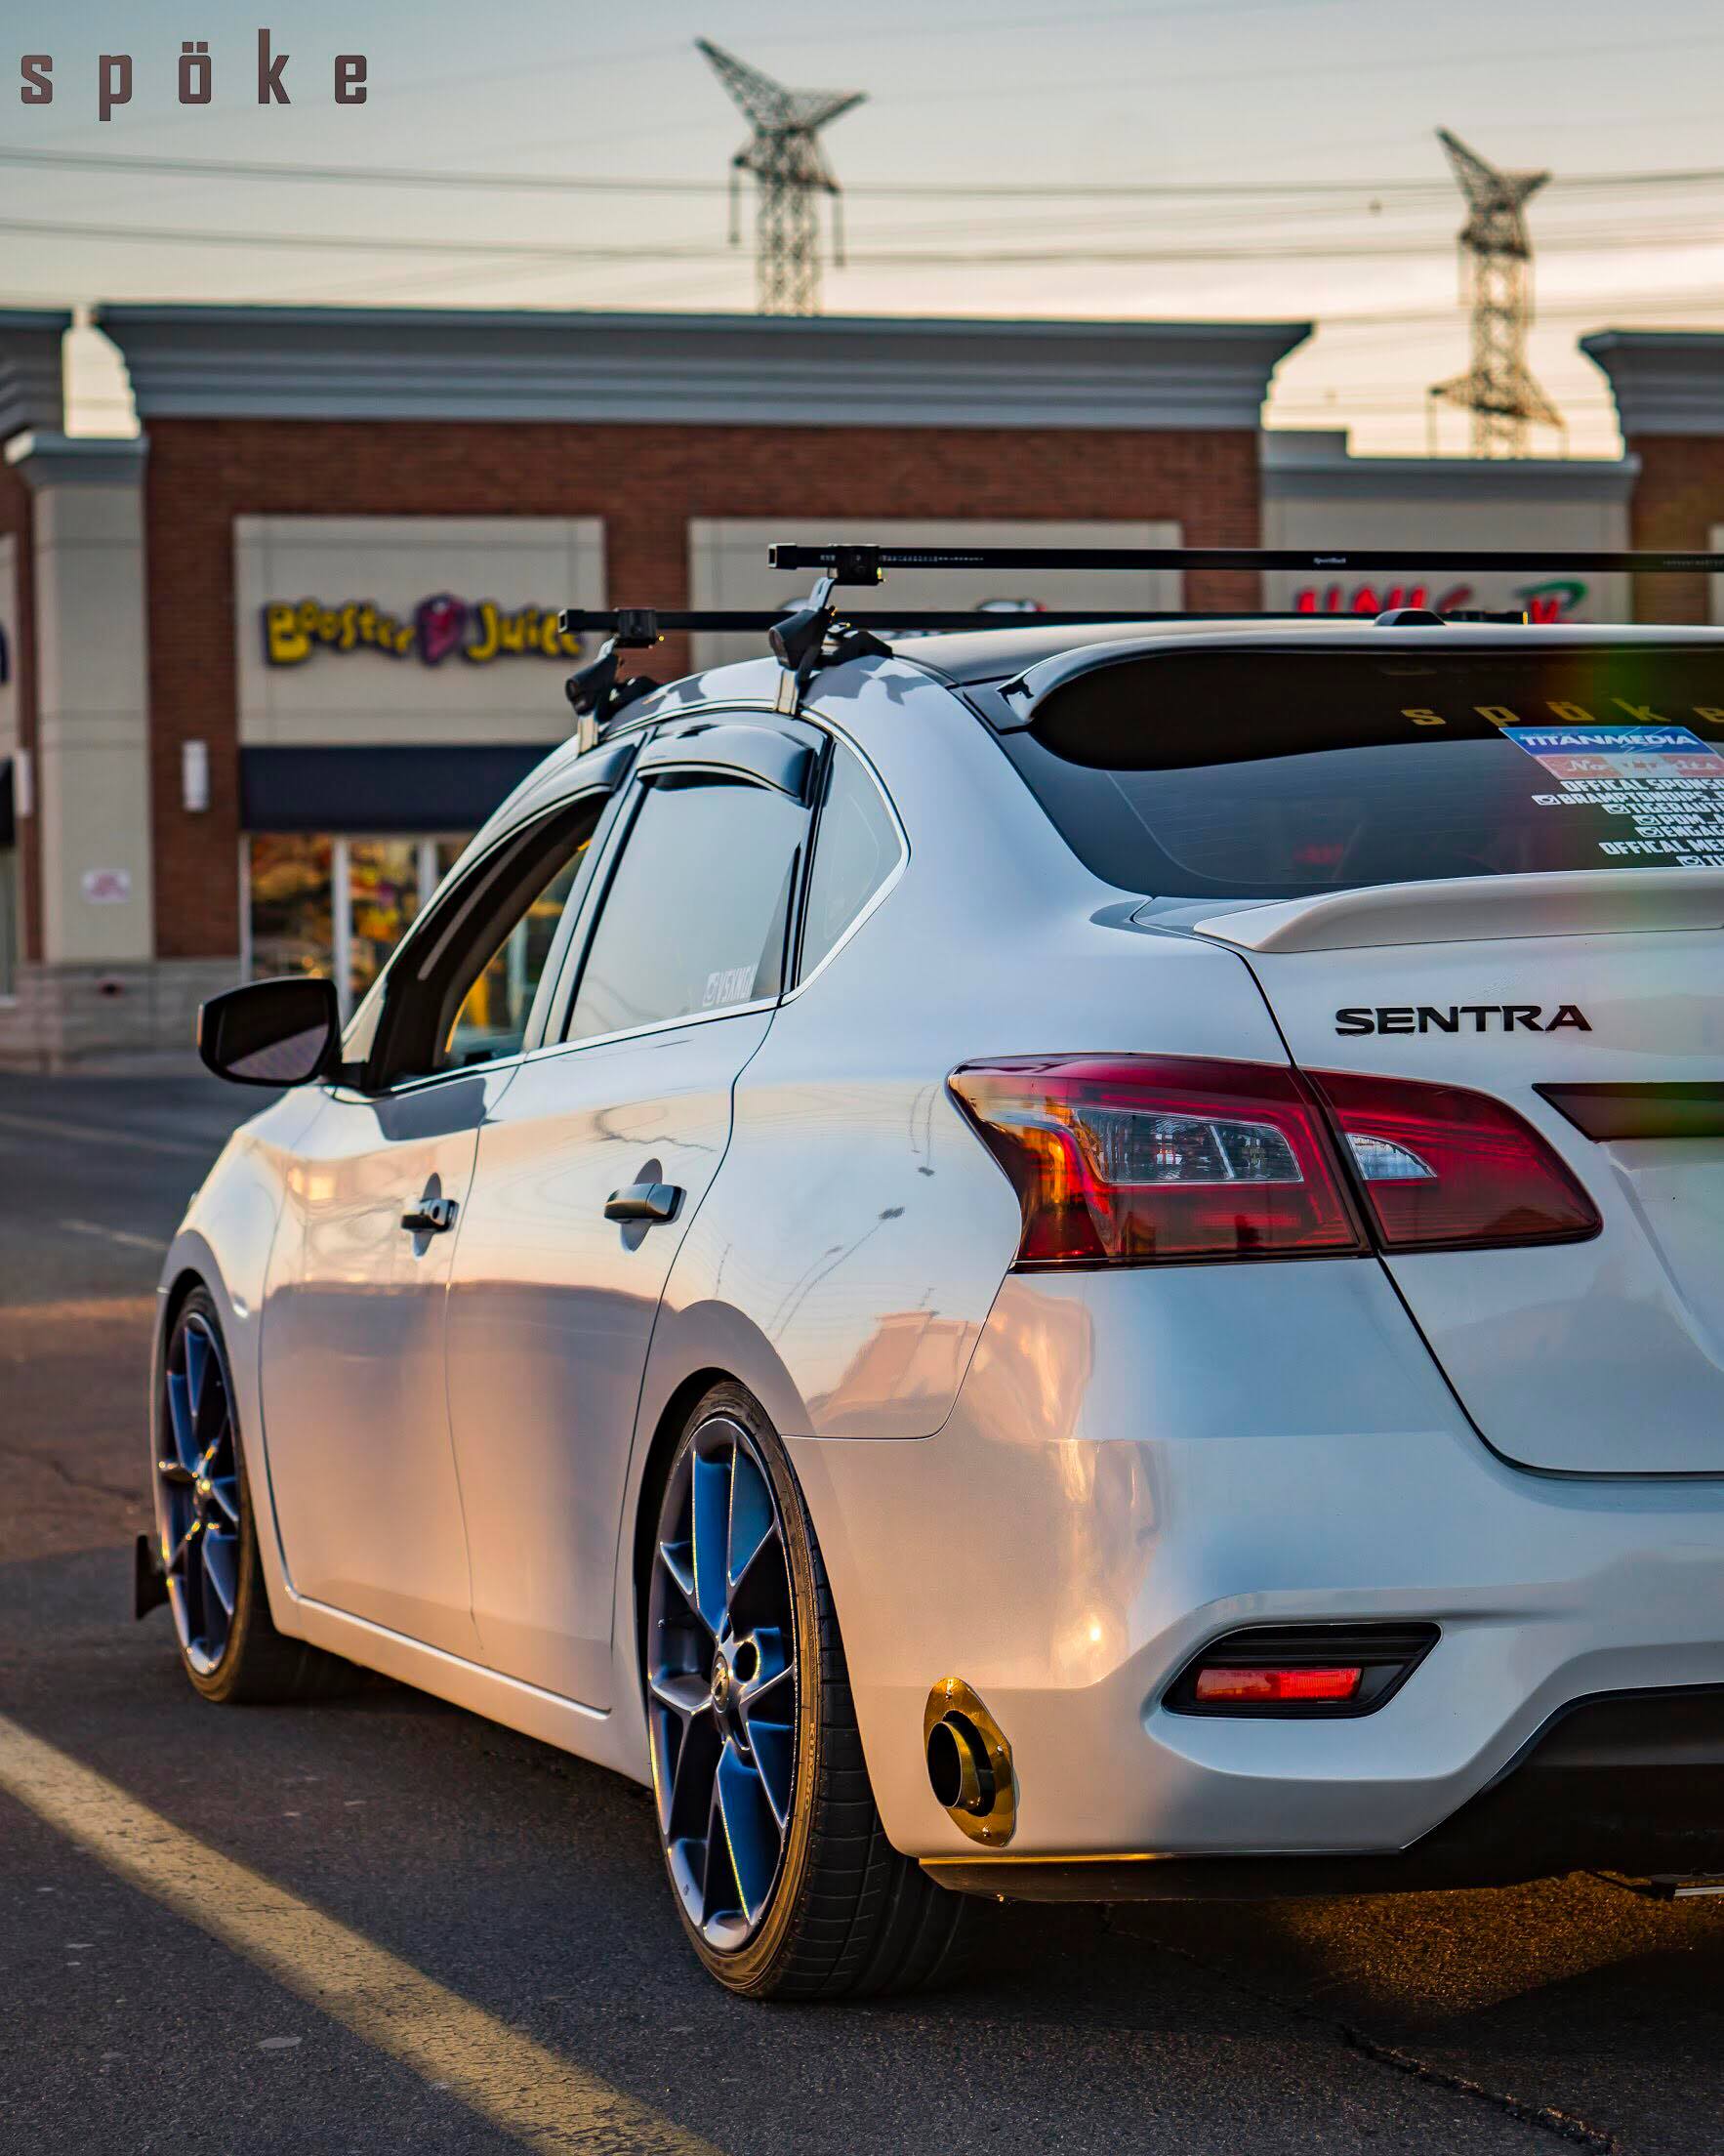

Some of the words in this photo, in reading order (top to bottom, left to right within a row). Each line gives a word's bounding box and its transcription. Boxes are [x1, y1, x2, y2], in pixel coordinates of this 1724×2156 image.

[1520, 734, 1700, 746] TITANMEDIA
[1560, 779, 1650, 792] OFFICAL
[1660, 825, 1724, 837] ENGAG
[1598, 840, 1691, 855] OFFICAL
[1334, 1005, 1593, 1035] SENTRA
